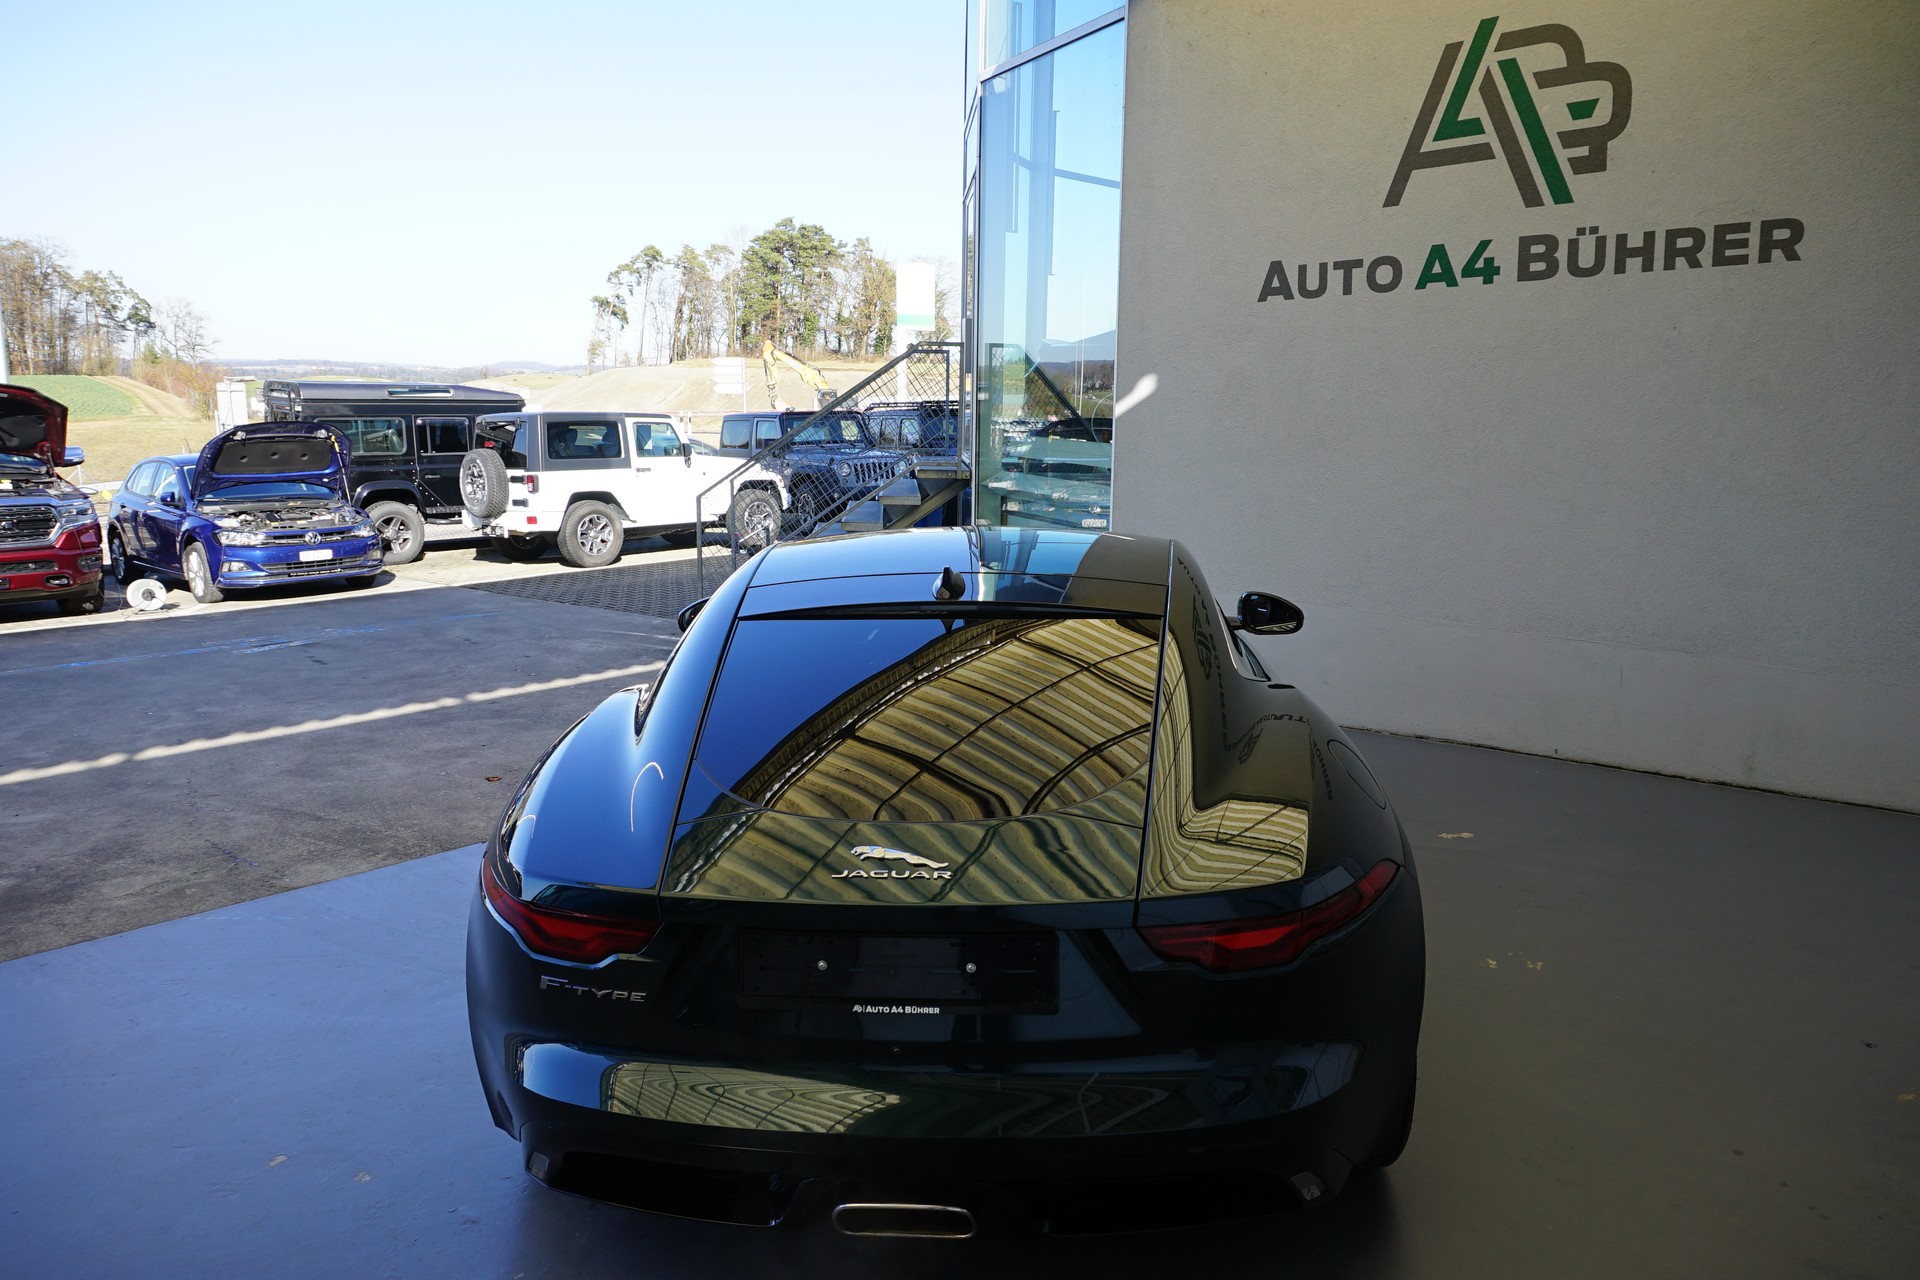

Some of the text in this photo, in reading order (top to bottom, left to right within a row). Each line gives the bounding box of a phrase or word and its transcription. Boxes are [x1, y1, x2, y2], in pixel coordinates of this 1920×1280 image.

[1257, 217, 1806, 303] AUTO A4 BÜHRER
[831, 869, 953, 880] JAGUAR
[539, 975, 647, 1002] F-TYPE
[865, 1005, 890, 1014] AUTO
[890, 1005, 904, 1014] A4
[904, 1005, 940, 1015] BÜHRER
